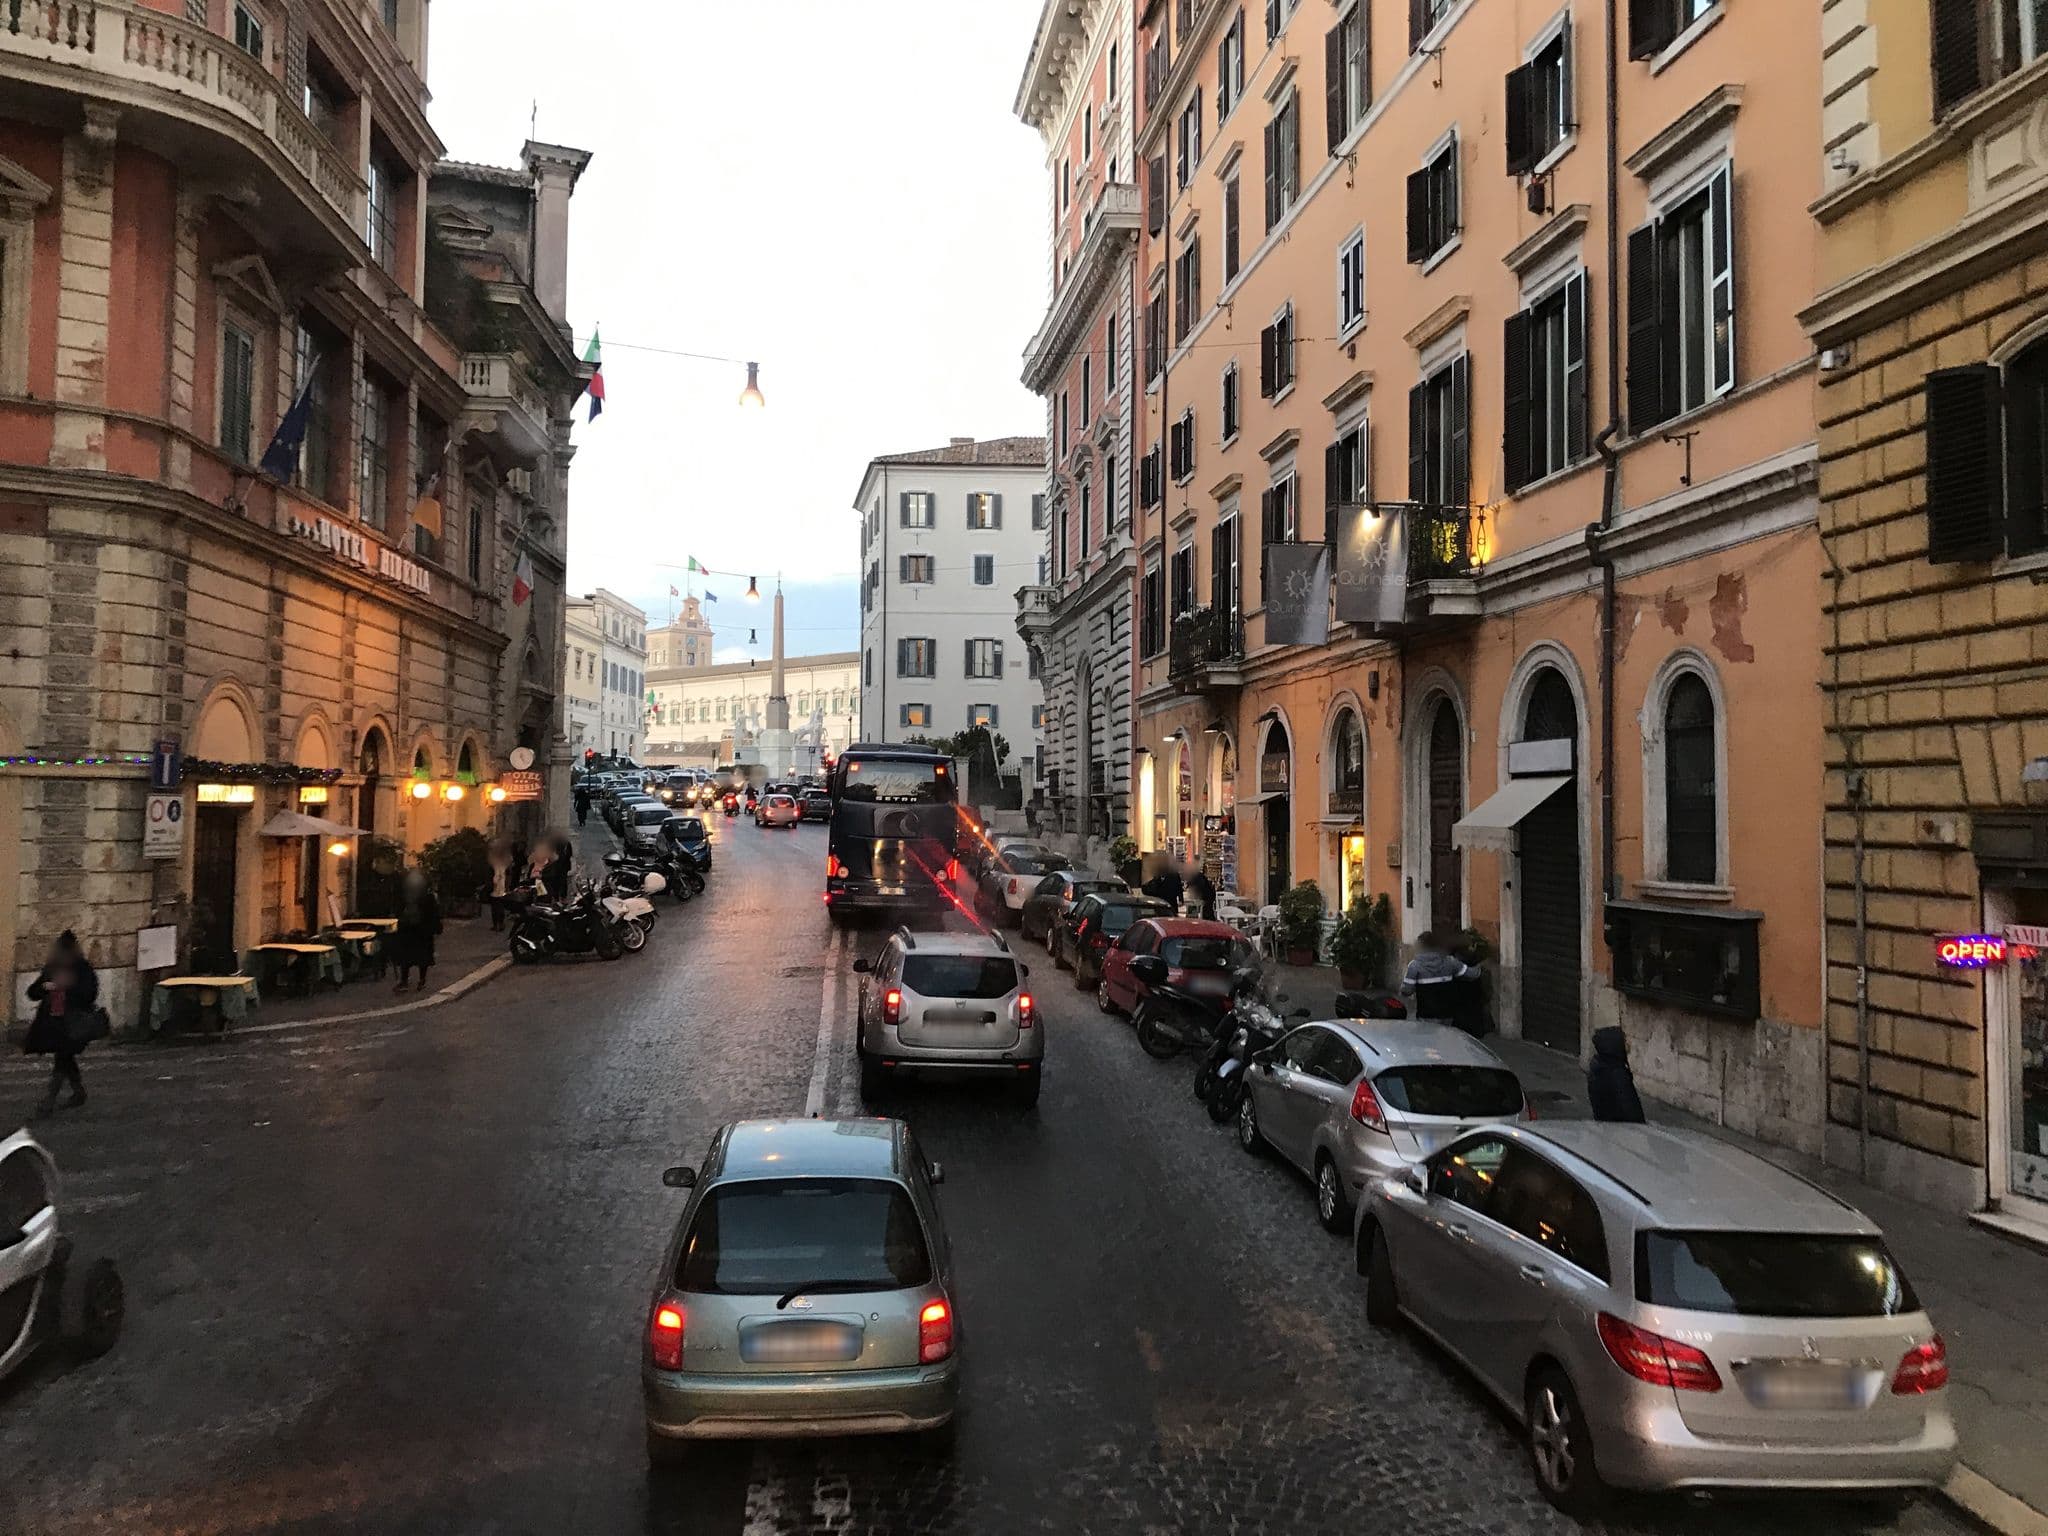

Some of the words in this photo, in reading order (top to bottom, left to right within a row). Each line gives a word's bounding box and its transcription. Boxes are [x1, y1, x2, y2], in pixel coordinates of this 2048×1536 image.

[318, 518, 369, 566] HOTEL
[1338, 569, 1406, 587] Quirinale
[1941, 943, 2001, 960] OPEN
